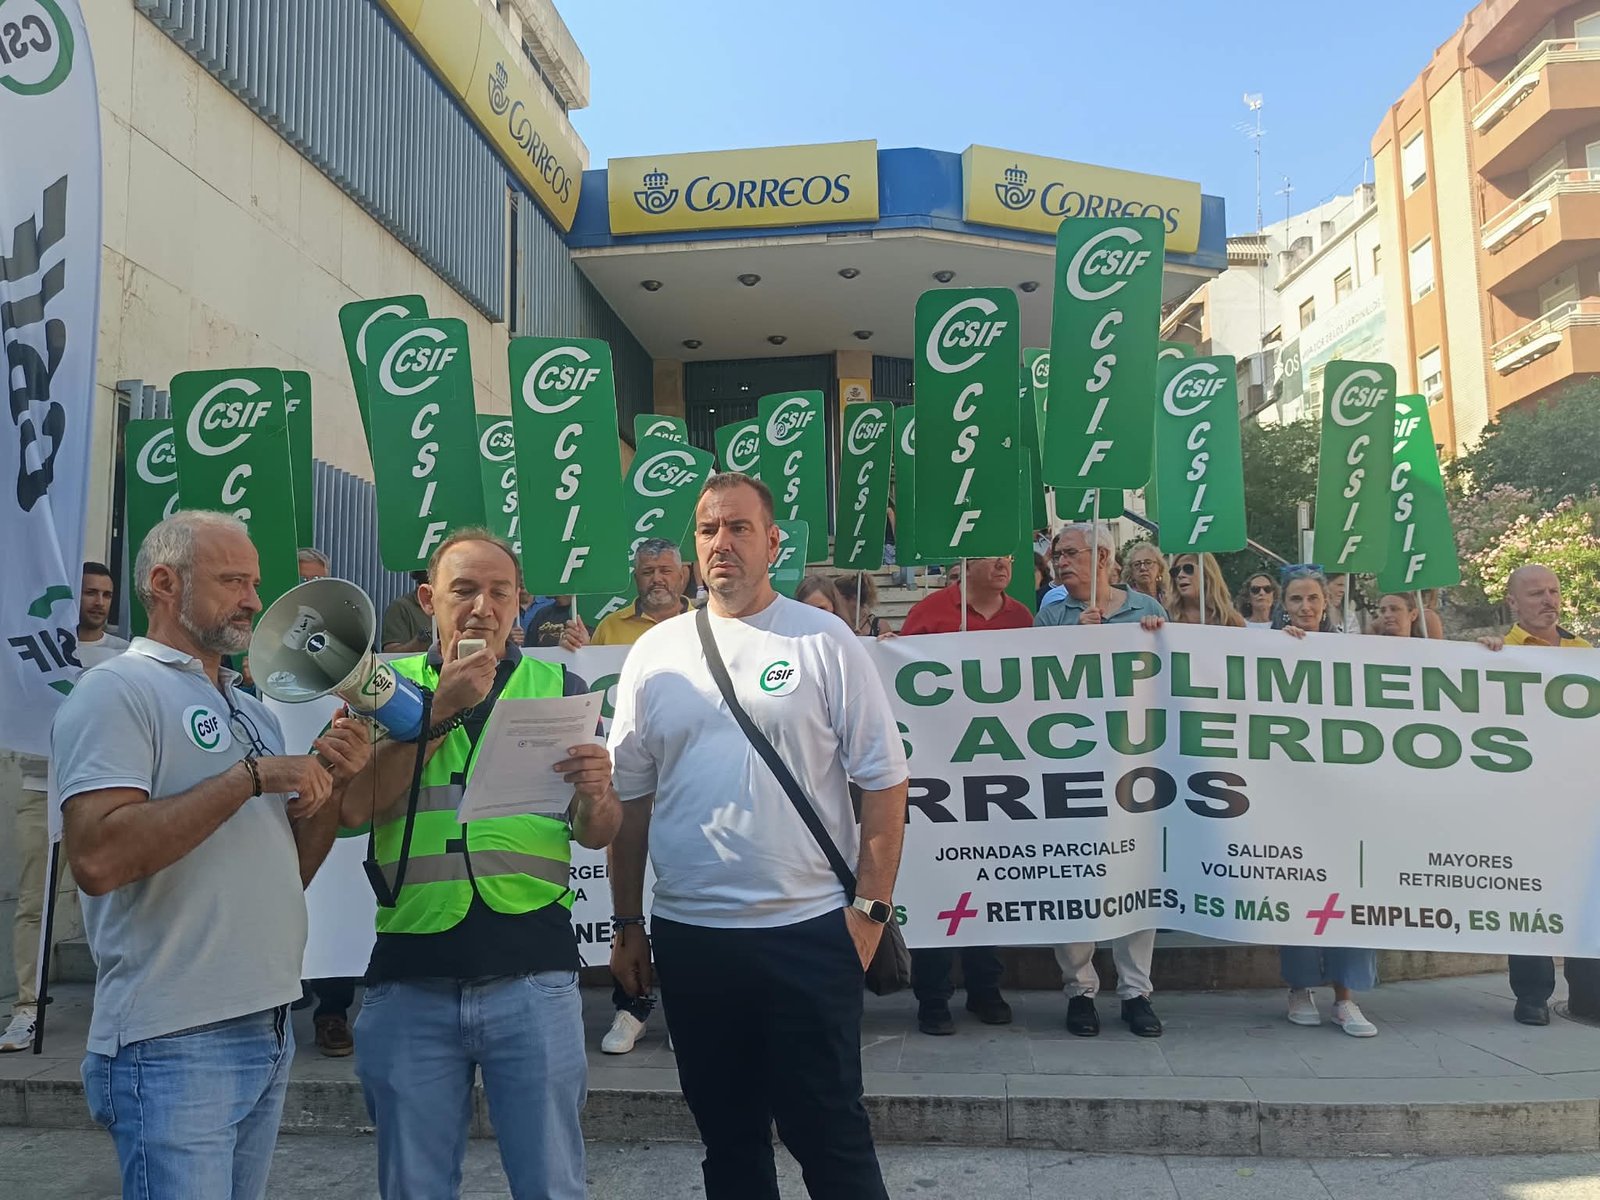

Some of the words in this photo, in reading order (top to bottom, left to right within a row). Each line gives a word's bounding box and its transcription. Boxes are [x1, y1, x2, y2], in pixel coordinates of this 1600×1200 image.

[508, 100, 572, 204] CORREOS
[685, 173, 851, 211] CORREOS
[1083, 249, 1152, 275] CSIF
[942, 321, 1008, 347] CSIF
[395, 348, 458, 373] CSIF
[538, 366, 600, 391] CSIF
[1176, 377, 1227, 398] CSIF
[1078, 311, 1123, 477] CSIF
[1342, 387, 1388, 408] CSIF
[203, 401, 272, 430] CSIF
[855, 422, 887, 441] CSIF
[735, 437, 760, 458] CSI
[648, 462, 699, 487] CSIF
[950, 383, 983, 547] CSIF
[411, 403, 447, 559] CSIF
[783, 450, 802, 520] CSI
[1186, 421, 1214, 545] CSIF
[554, 423, 590, 584] CSIF
[848, 461, 874, 562] CSIF
[1337, 435, 1370, 564] CSIF
[1391, 462, 1426, 583] CSIF
[373, 674, 393, 692] CSIF
[766, 668, 794, 682] CSIF
[895, 651, 1600, 719] CUMPLIMIENTO
[198, 716, 219, 737] CSIF
[950, 709, 1533, 773] ACUERDOS
[848, 766, 1251, 824] RREOS
[936, 844, 1037, 861] JORNADAS
[1043, 838, 1135, 858] PARCIALES
[1227, 843, 1303, 860] SALIDAS
[1428, 852, 1513, 870] MAYORES
[976, 868, 989, 881] A
[994, 863, 1107, 881] COMPLETAS
[1201, 862, 1328, 882] VOLUNTARIAS
[1399, 872, 1542, 892] RETRIBUCIONES
[987, 888, 1186, 923] RETRIBUCIONES,
[1194, 893, 1226, 917] ES
[1234, 896, 1290, 922] MÁS
[1351, 904, 1461, 934] EMPLEO,
[1469, 910, 1501, 932] ES
[1509, 908, 1564, 934] MÁS
